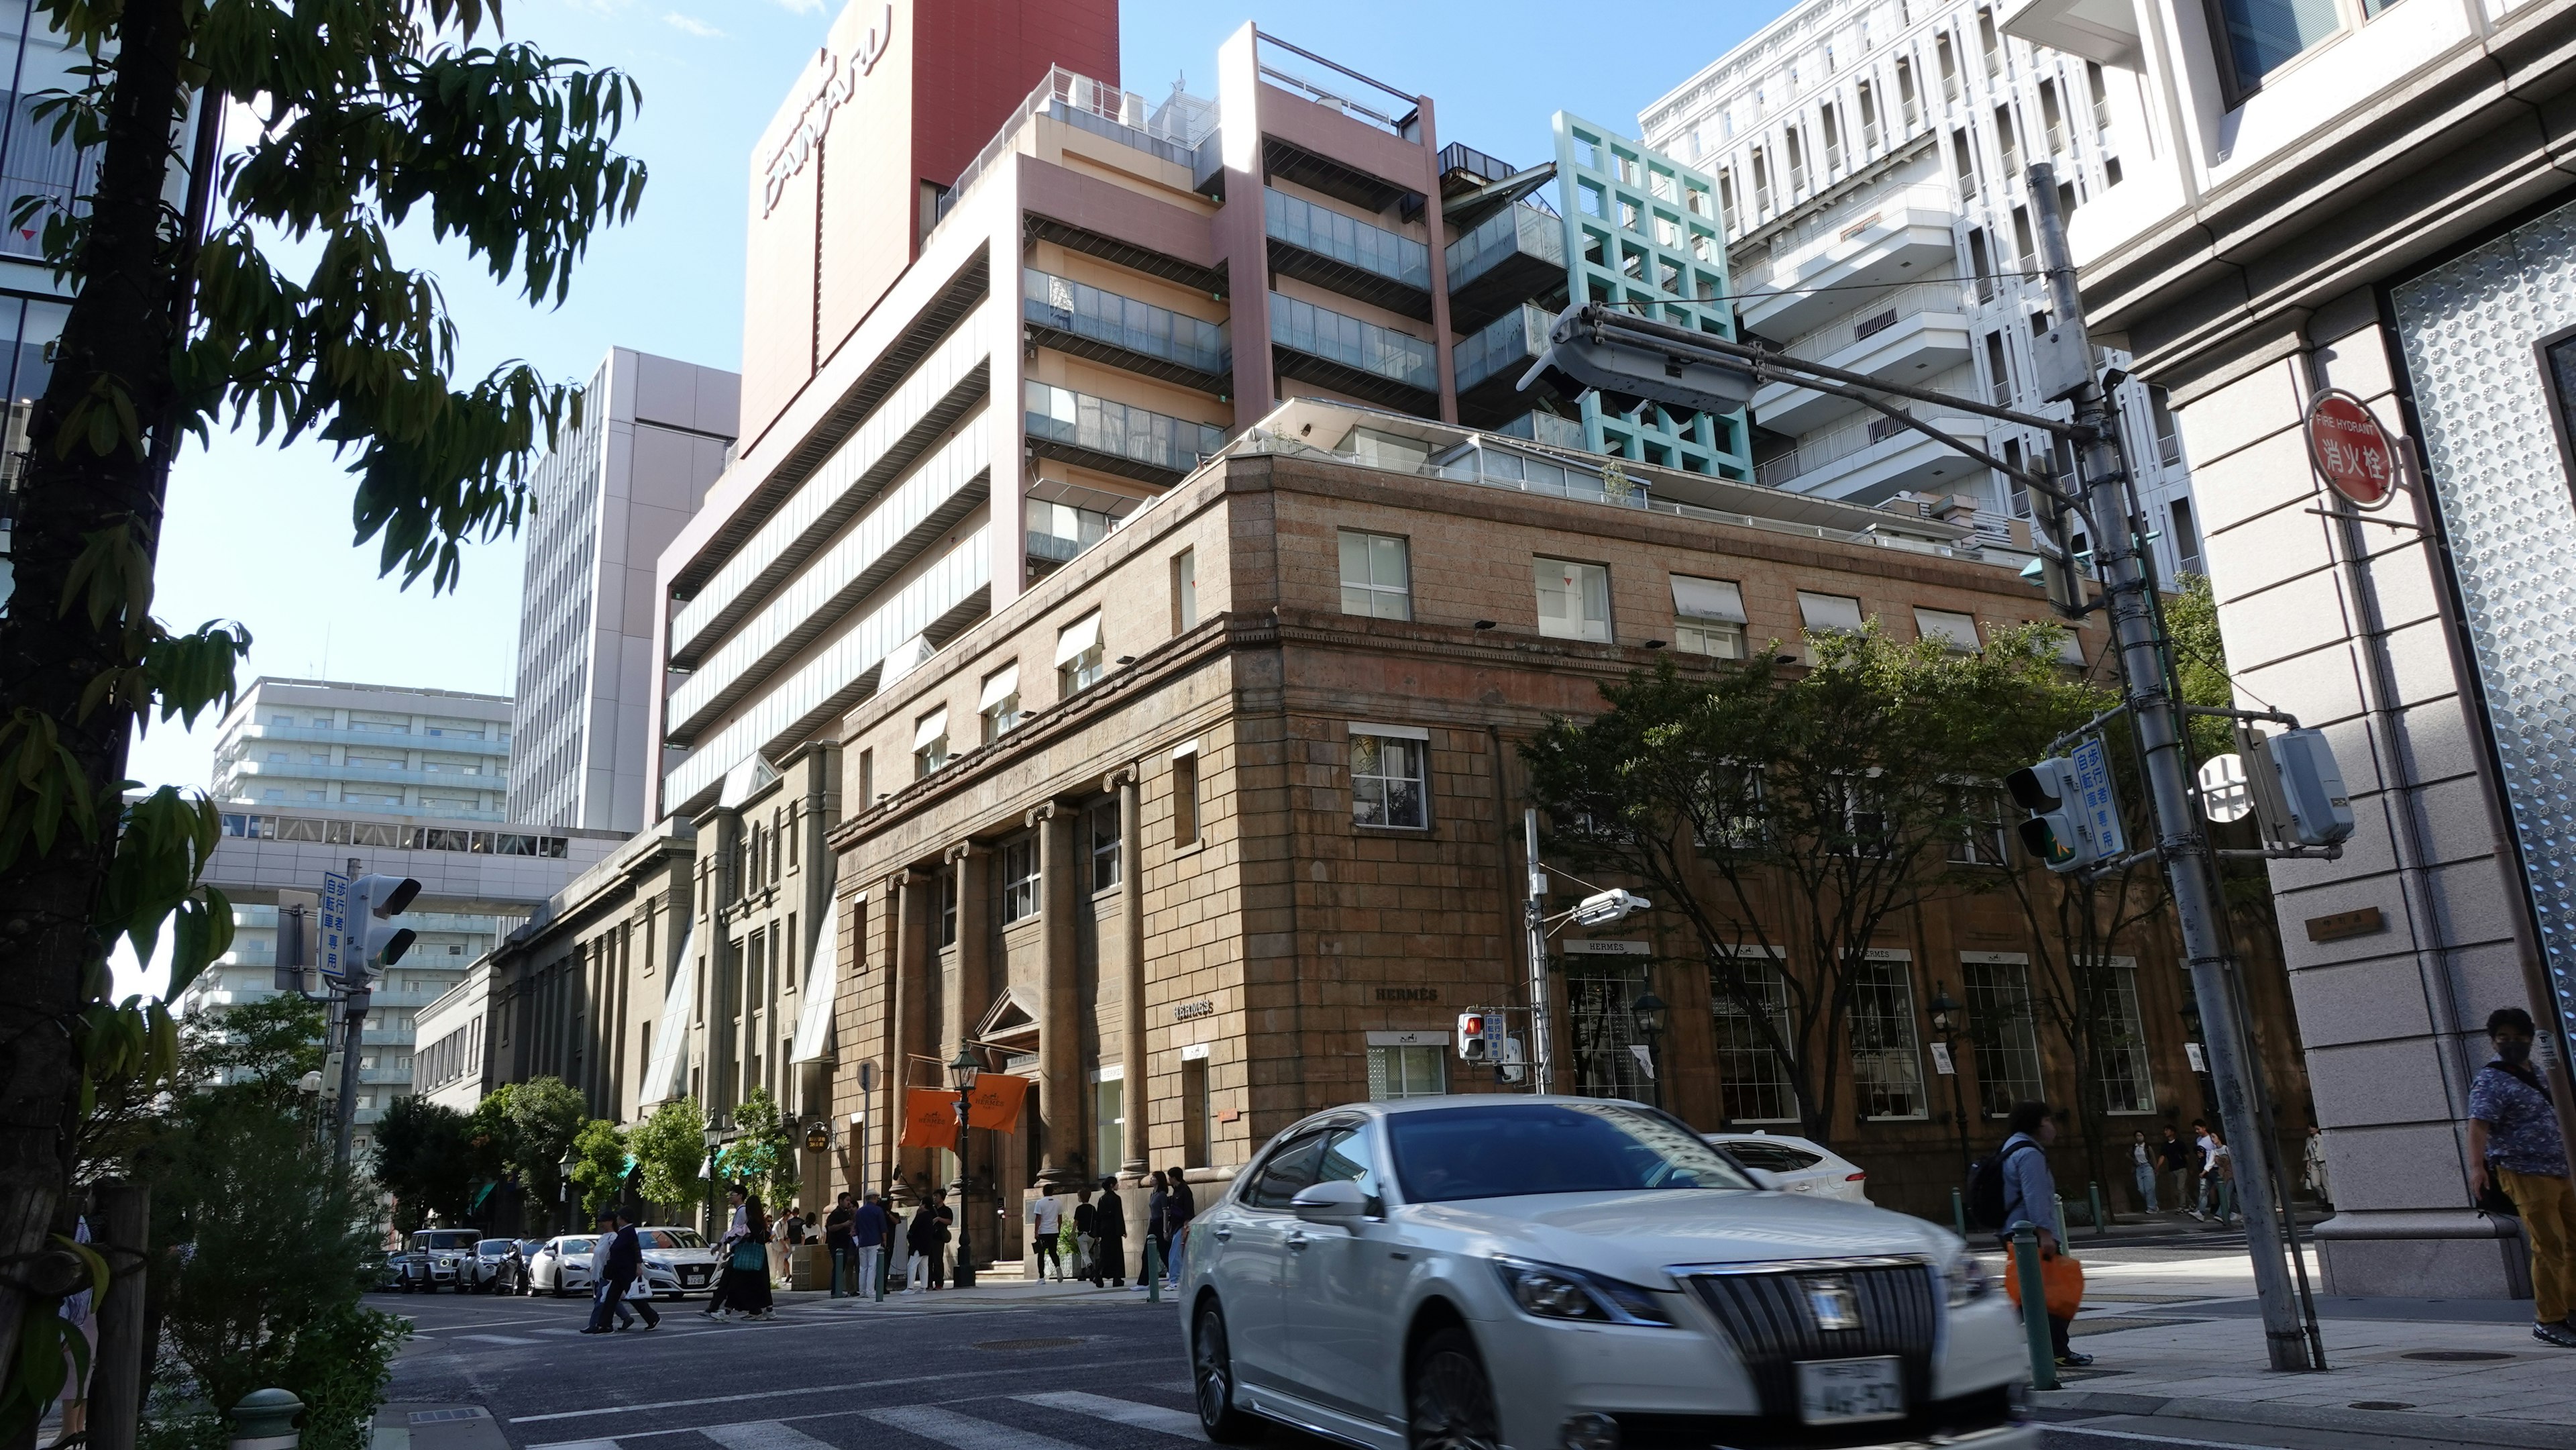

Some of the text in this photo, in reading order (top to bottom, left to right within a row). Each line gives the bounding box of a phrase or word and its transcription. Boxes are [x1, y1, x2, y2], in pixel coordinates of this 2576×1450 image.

[2316, 415, 2374, 435] FIRE HYDRANT
[2322, 438, 2384, 479] 消火栓
[2078, 754, 2098, 808] 自転車
[2088, 748, 2108, 803] 歩行者
[2097, 811, 2112, 848] 専用
[324, 879, 335, 929] 自転車
[335, 882, 346, 931] 歩行者
[327, 934, 338, 969] 専用
[1491, 1042, 1498, 1057] 専用
